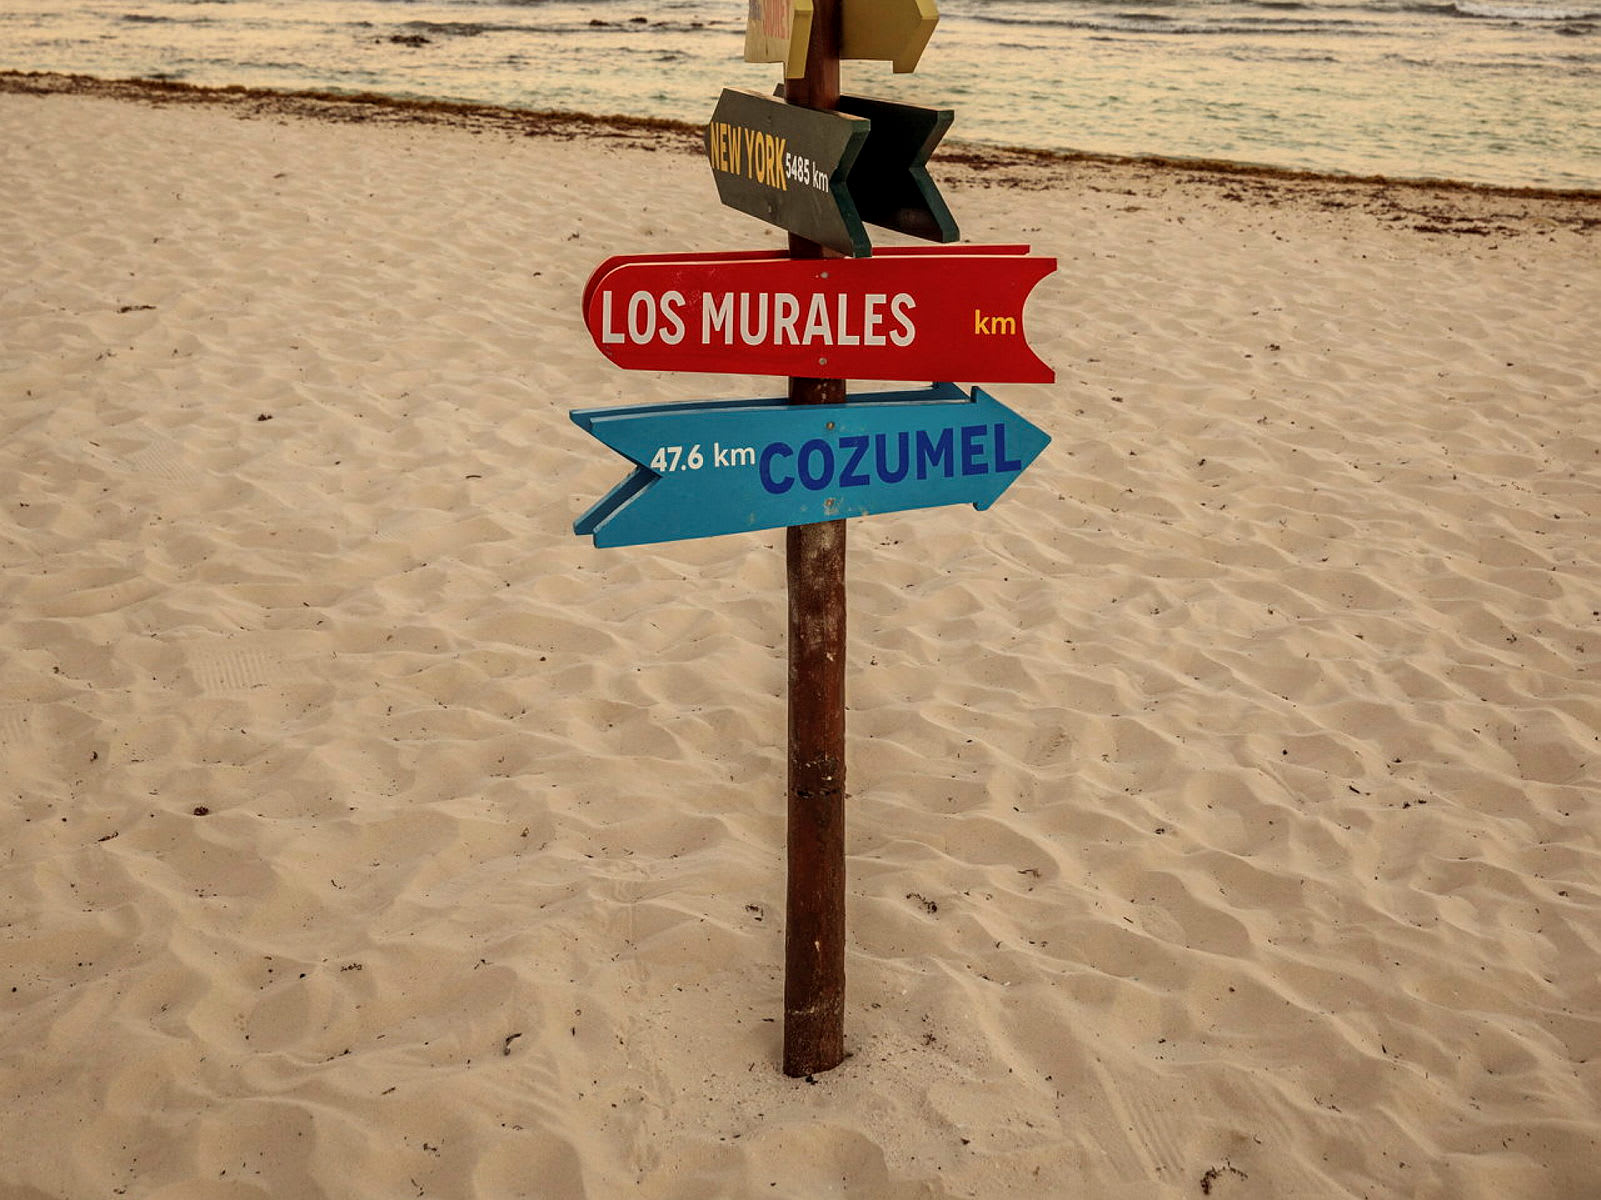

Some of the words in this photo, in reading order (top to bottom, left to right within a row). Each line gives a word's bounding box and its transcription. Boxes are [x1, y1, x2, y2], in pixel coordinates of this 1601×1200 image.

[710, 121, 741, 176] NEW
[744, 127, 787, 191] YORK
[785, 152, 809, 185] 5485
[812, 161, 829, 193] km
[601, 290, 686, 346] LOS
[702, 291, 917, 347] MURALES
[974, 309, 1016, 335] km
[650, 444, 703, 473] 47.6
[714, 442, 756, 468] km
[758, 423, 1022, 495] COZUMEL
